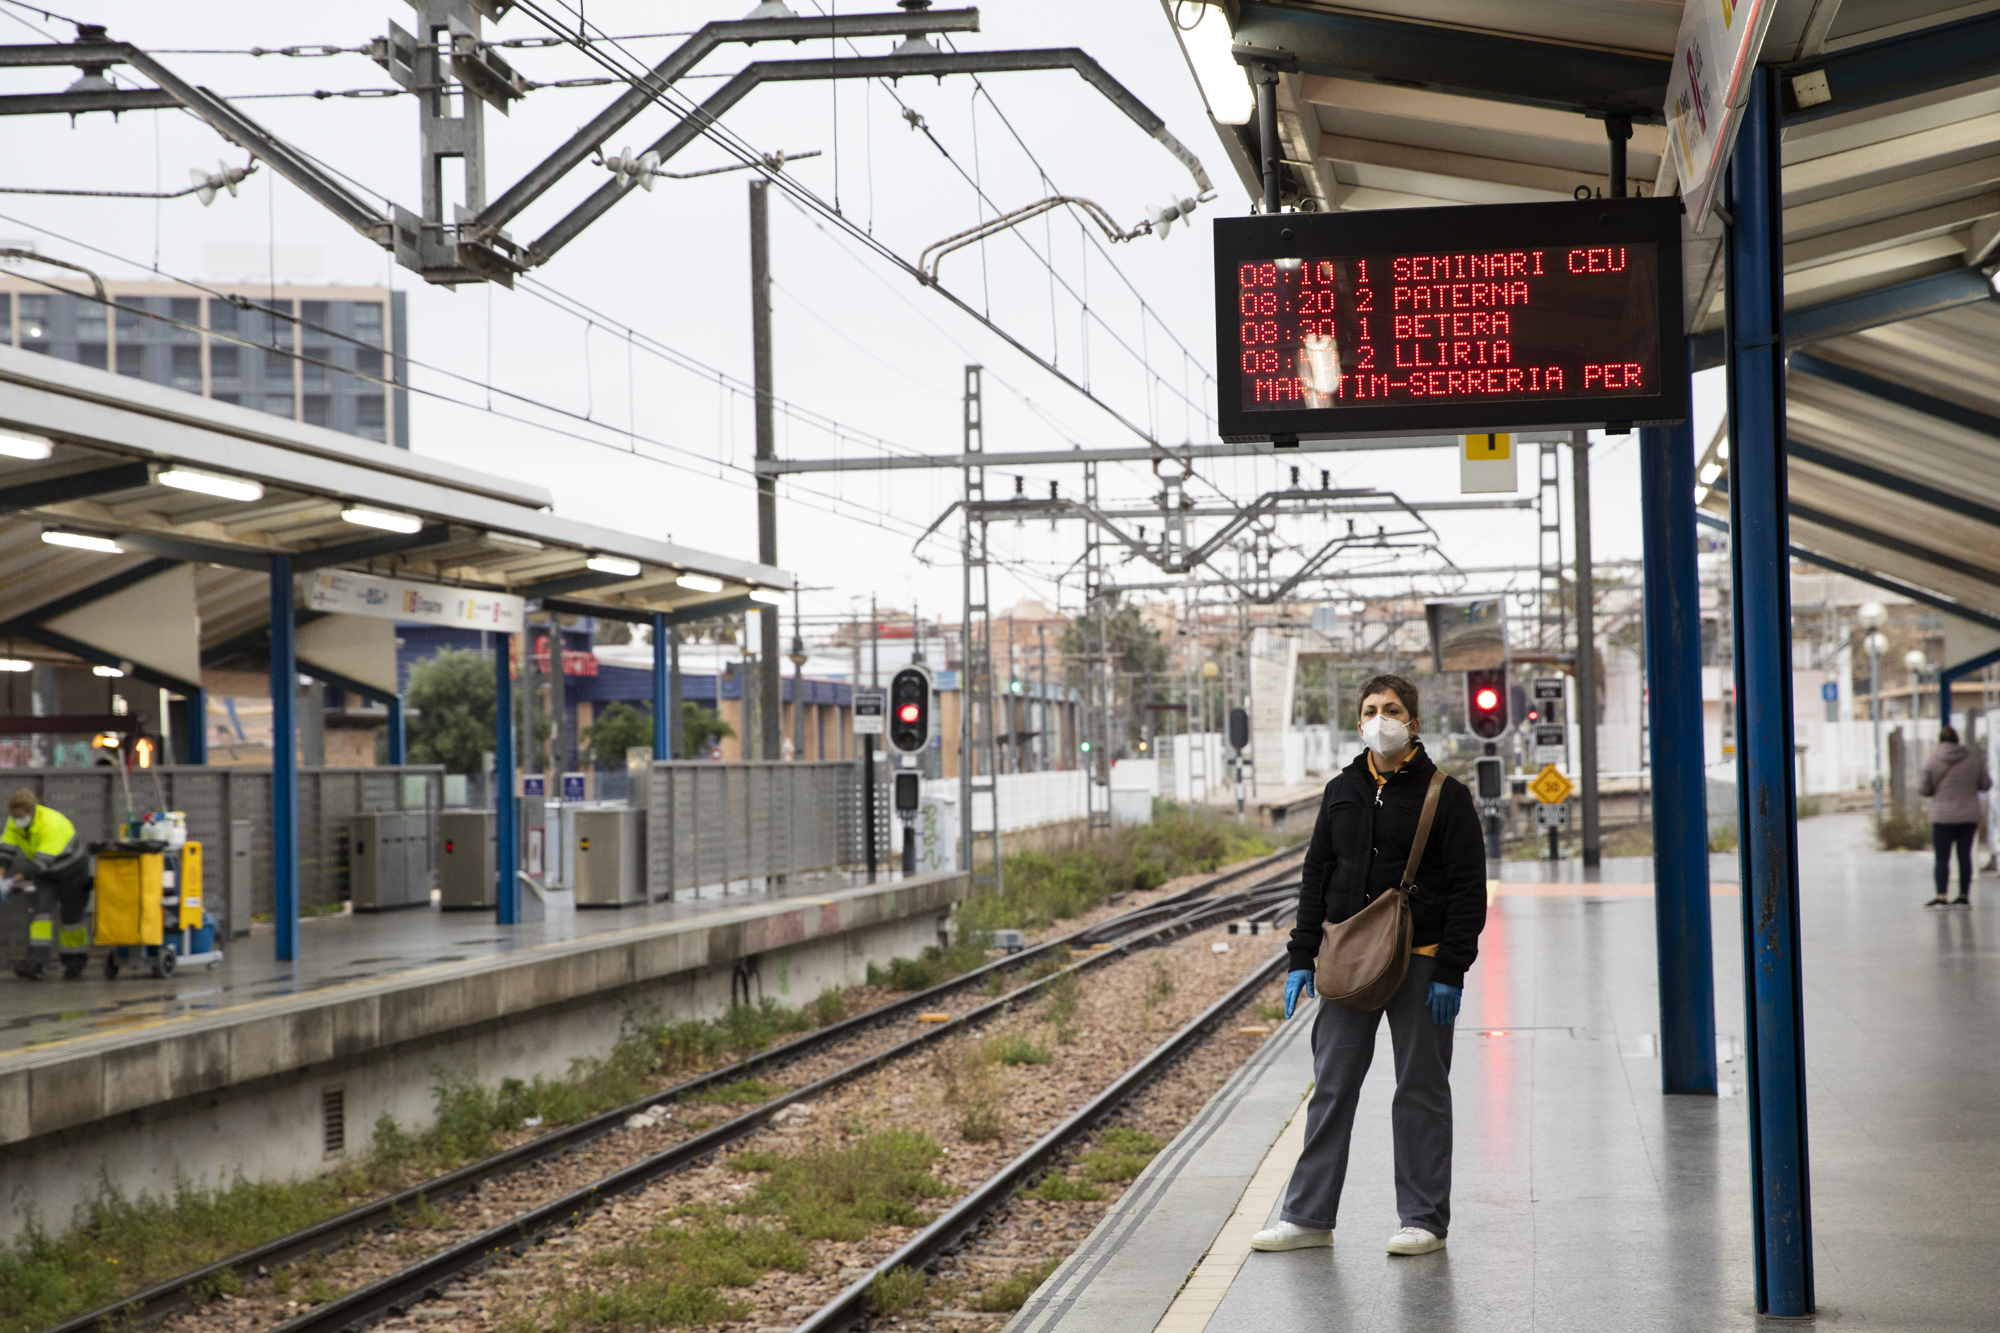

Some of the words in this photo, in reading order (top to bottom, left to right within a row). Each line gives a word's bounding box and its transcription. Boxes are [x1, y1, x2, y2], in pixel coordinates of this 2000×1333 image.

[1240, 260, 1334, 287] 08:10
[1357, 259, 1369, 283] 1
[1393, 251, 1544, 281] SEMINARI
[1568, 247, 1626, 274] CEU
[1241, 289, 1335, 316] 08:20
[1355, 288, 1373, 311] 2
[1394, 281, 1529, 310] PATERNA
[1241, 318, 1336, 345] 08:30
[1359, 317, 1371, 340] 1
[1394, 311, 1510, 339] BETERA
[1357, 345, 1375, 369] 2
[1395, 340, 1511, 368] LLIRIA
[1256, 366, 1563, 402] MARITIM-SERRERIA
[1584, 363, 1643, 389] PER
